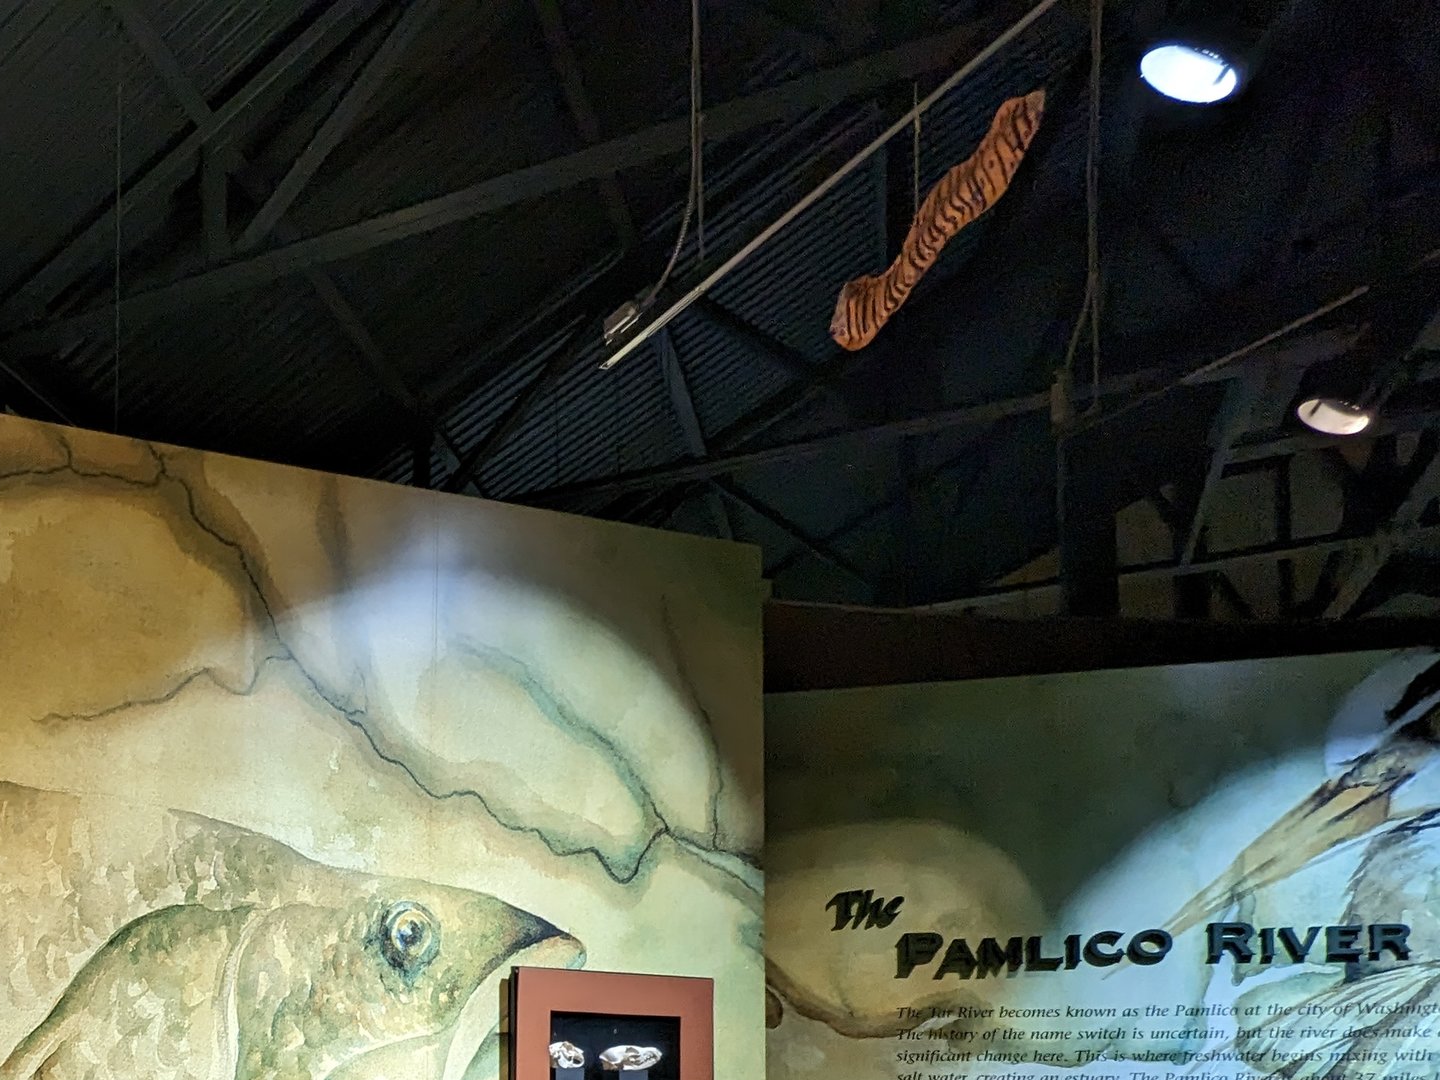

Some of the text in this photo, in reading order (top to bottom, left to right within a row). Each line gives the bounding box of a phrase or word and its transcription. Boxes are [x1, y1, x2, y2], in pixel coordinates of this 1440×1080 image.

[825, 889, 905, 933] The
[893, 921, 1412, 980] PAMLICO RIVER
[896, 1003, 1440, 1018] The Tar River becomes known as the Pamlico at the city of Washingt
[896, 1028, 923, 1040] The
[928, 1028, 977, 1041] history
[983, 1027, 1001, 1042] of
[1003, 1028, 1025, 1040] the
[1031, 1031, 1072, 1040] name
[1077, 1027, 1125, 1040] switch
[1133, 1028, 1145, 1040] is
[1151, 1028, 1230, 1041] uncertain,
[1237, 1027, 1261, 1039] but
[1269, 1027, 1294, 1039] the
[1300, 1028, 1336, 1038] river
[1385, 1026, 1431, 1038] make
[896, 1049, 1432, 1064] significant change here. This is where freshwater begins mixing with
